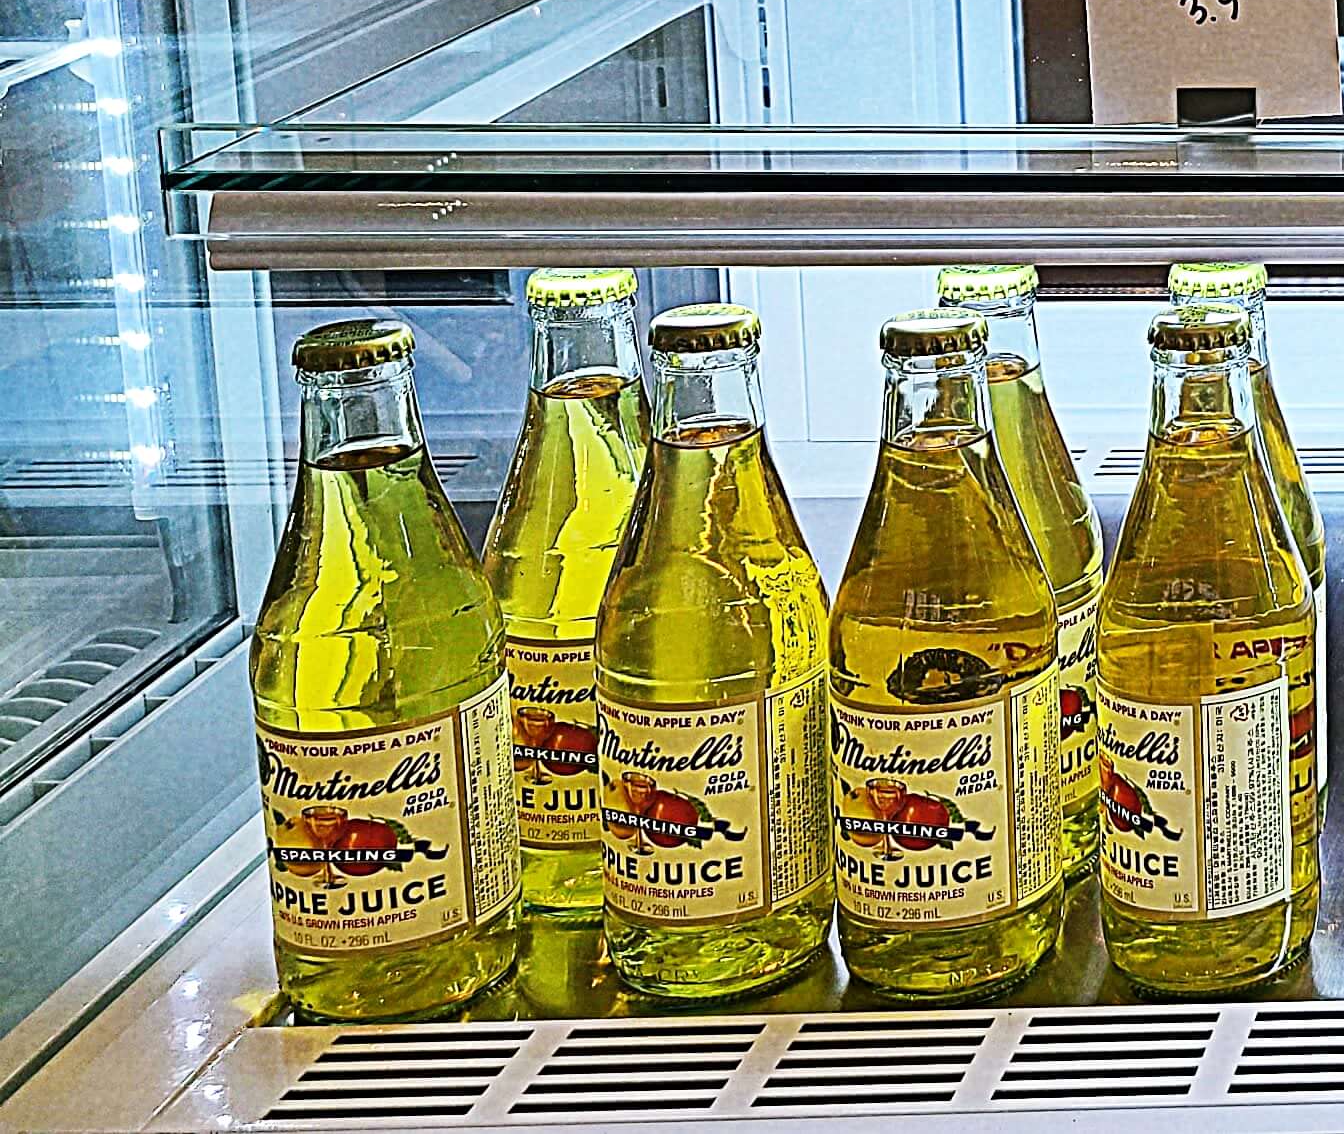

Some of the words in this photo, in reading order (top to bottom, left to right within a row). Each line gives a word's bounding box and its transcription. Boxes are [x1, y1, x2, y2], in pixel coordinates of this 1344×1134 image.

[1058, 615, 1077, 629] PPLE
[518, 651, 548, 662] YOUR
[552, 651, 590, 662] APPLE
[508, 673, 596, 703] artine
[1112, 702, 1136, 717] APPLE
[1140, 710, 1147, 720] A
[622, 712, 650, 727] YOUR
[654, 717, 691, 728] APPLE
[696, 716, 706, 727] A
[867, 719, 900, 730] YOUR
[904, 719, 943, 730] APPLE
[947, 718, 957, 728] A
[301, 747, 338, 757] YOUR
[342, 740, 385, 756] APPLE
[391, 738, 401, 748] A
[600, 713, 743, 771] Martinelli's
[838, 722, 991, 774] Martinelli's
[514, 747, 596, 763] ARKLING
[267, 752, 441, 800] Martinelli's
[708, 771, 745, 784] GOLD
[960, 770, 995, 784] GOLD
[1149, 770, 1181, 780] GOLD
[705, 780, 750, 795] MEDAL
[956, 781, 998, 796] MEDAL
[1146, 779, 1185, 790] MEDAL
[406, 787, 445, 804] GOLD
[544, 788, 596, 811] JUI
[403, 797, 450, 817] MEDAL
[577, 813, 600, 822] APPL
[605, 810, 697, 836] SPARKLING
[552, 830, 569, 840] 296
[845, 818, 948, 837] SPARKLING
[280, 850, 397, 861] SPARKLING
[601, 842, 639, 879] PPLE
[646, 856, 743, 885] JUICE
[1110, 842, 1178, 877] JUICE
[895, 855, 992, 887] JUICE
[1127, 875, 1154, 888] APPLES
[338, 874, 446, 915] JUICE
[648, 886, 675, 898] FRESH
[677, 887, 713, 898] APPLES
[865, 890, 896, 901] GROWN
[897, 891, 926, 902] FRESH
[928, 888, 965, 900] APPLES
[305, 918, 340, 929] GROWN
[342, 919, 374, 929] FRESH
[376, 910, 417, 926] APPLES
